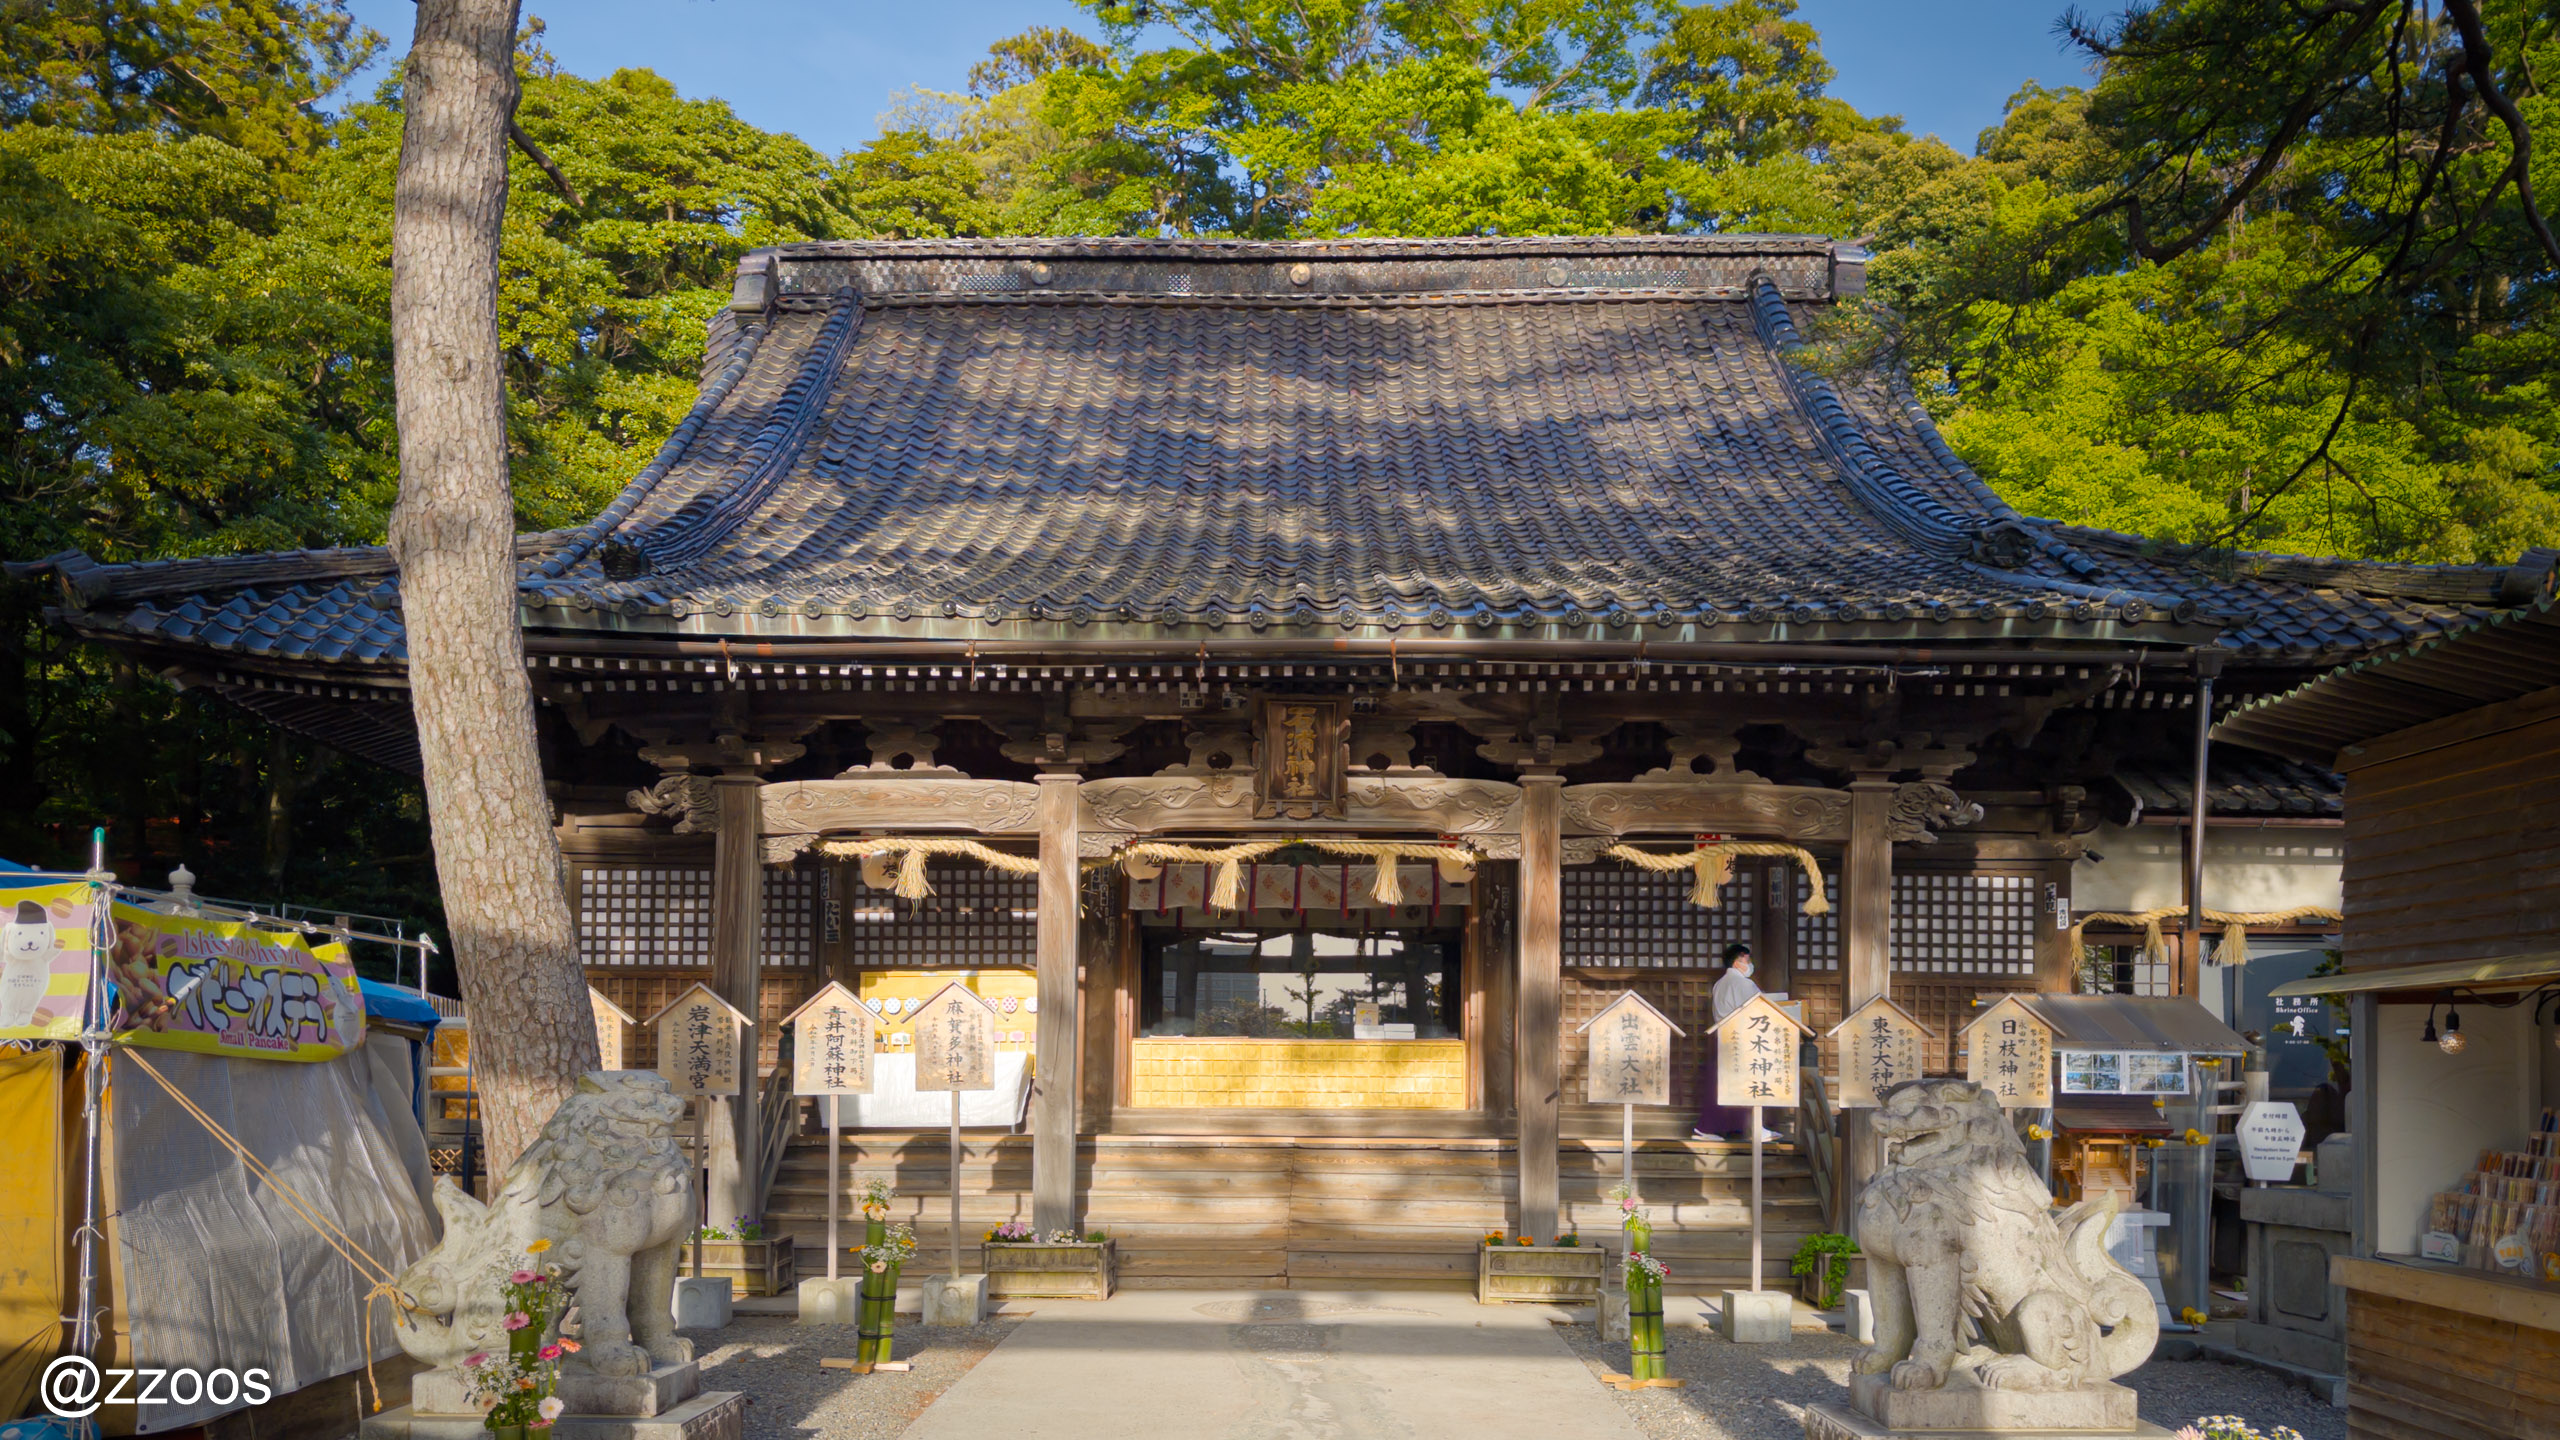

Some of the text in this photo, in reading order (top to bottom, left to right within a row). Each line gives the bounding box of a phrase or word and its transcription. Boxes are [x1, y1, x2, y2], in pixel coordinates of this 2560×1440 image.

[1283, 706, 1317, 798] 石浦神社
[248, 1033, 289, 1050] Pancake
[687, 1005, 712, 1090] 岩津天満宮
[824, 1006, 847, 1088] 青井阿蘇神社
[946, 1000, 965, 1083] 麻賀多神社
[1617, 1013, 1643, 1095] 出雲大社
[1747, 1015, 1775, 1099] 乃木神社
[1998, 1019, 2020, 1097] 日枝神社
